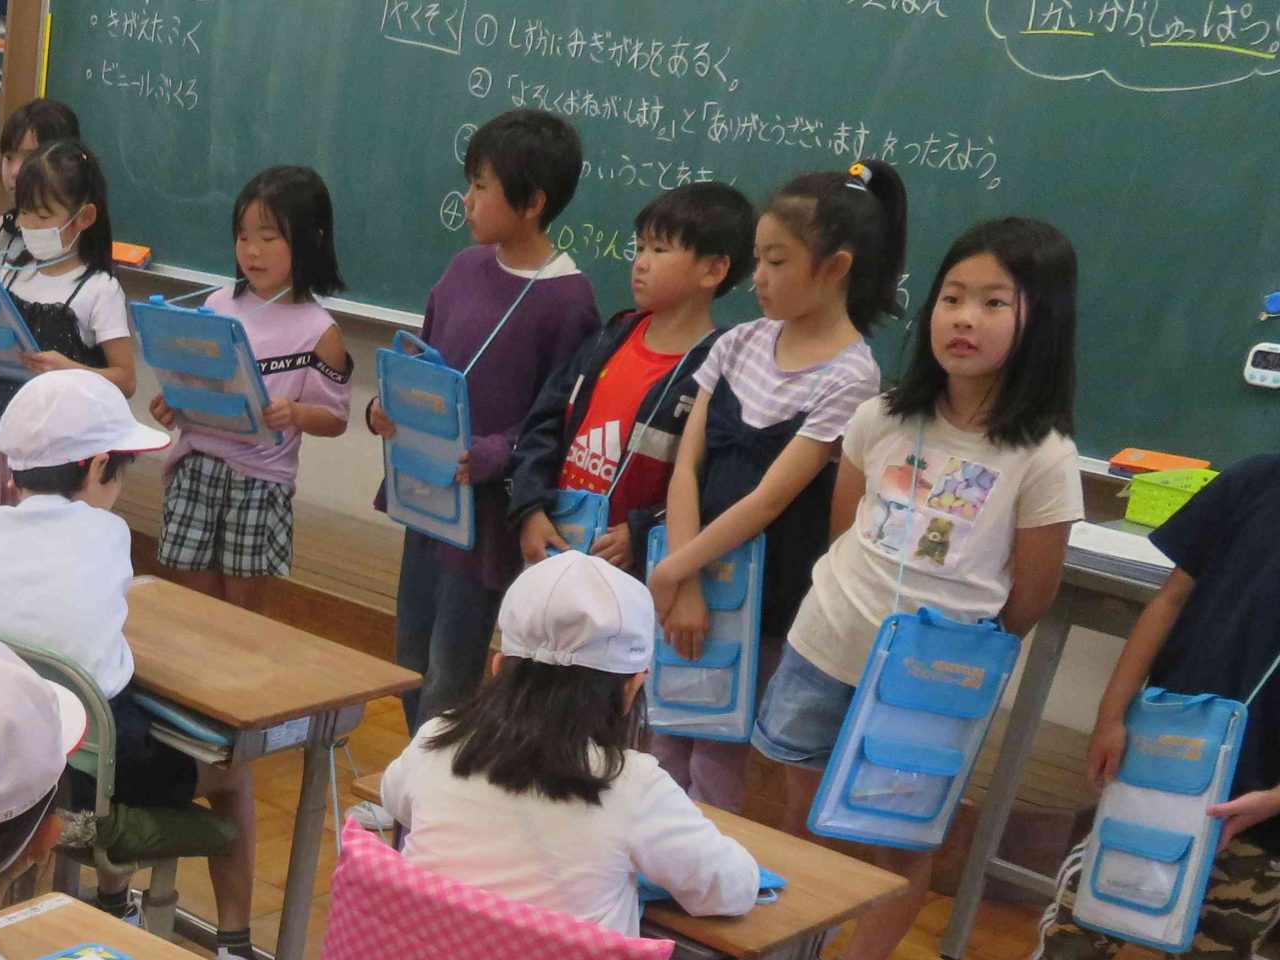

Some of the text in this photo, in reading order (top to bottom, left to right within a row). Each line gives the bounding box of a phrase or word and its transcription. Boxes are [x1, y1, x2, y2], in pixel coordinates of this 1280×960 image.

[102, 60, 198, 110] ビニールぶくろ
[270, 359, 293, 371] DAY
[567, 444, 619, 482] adida
